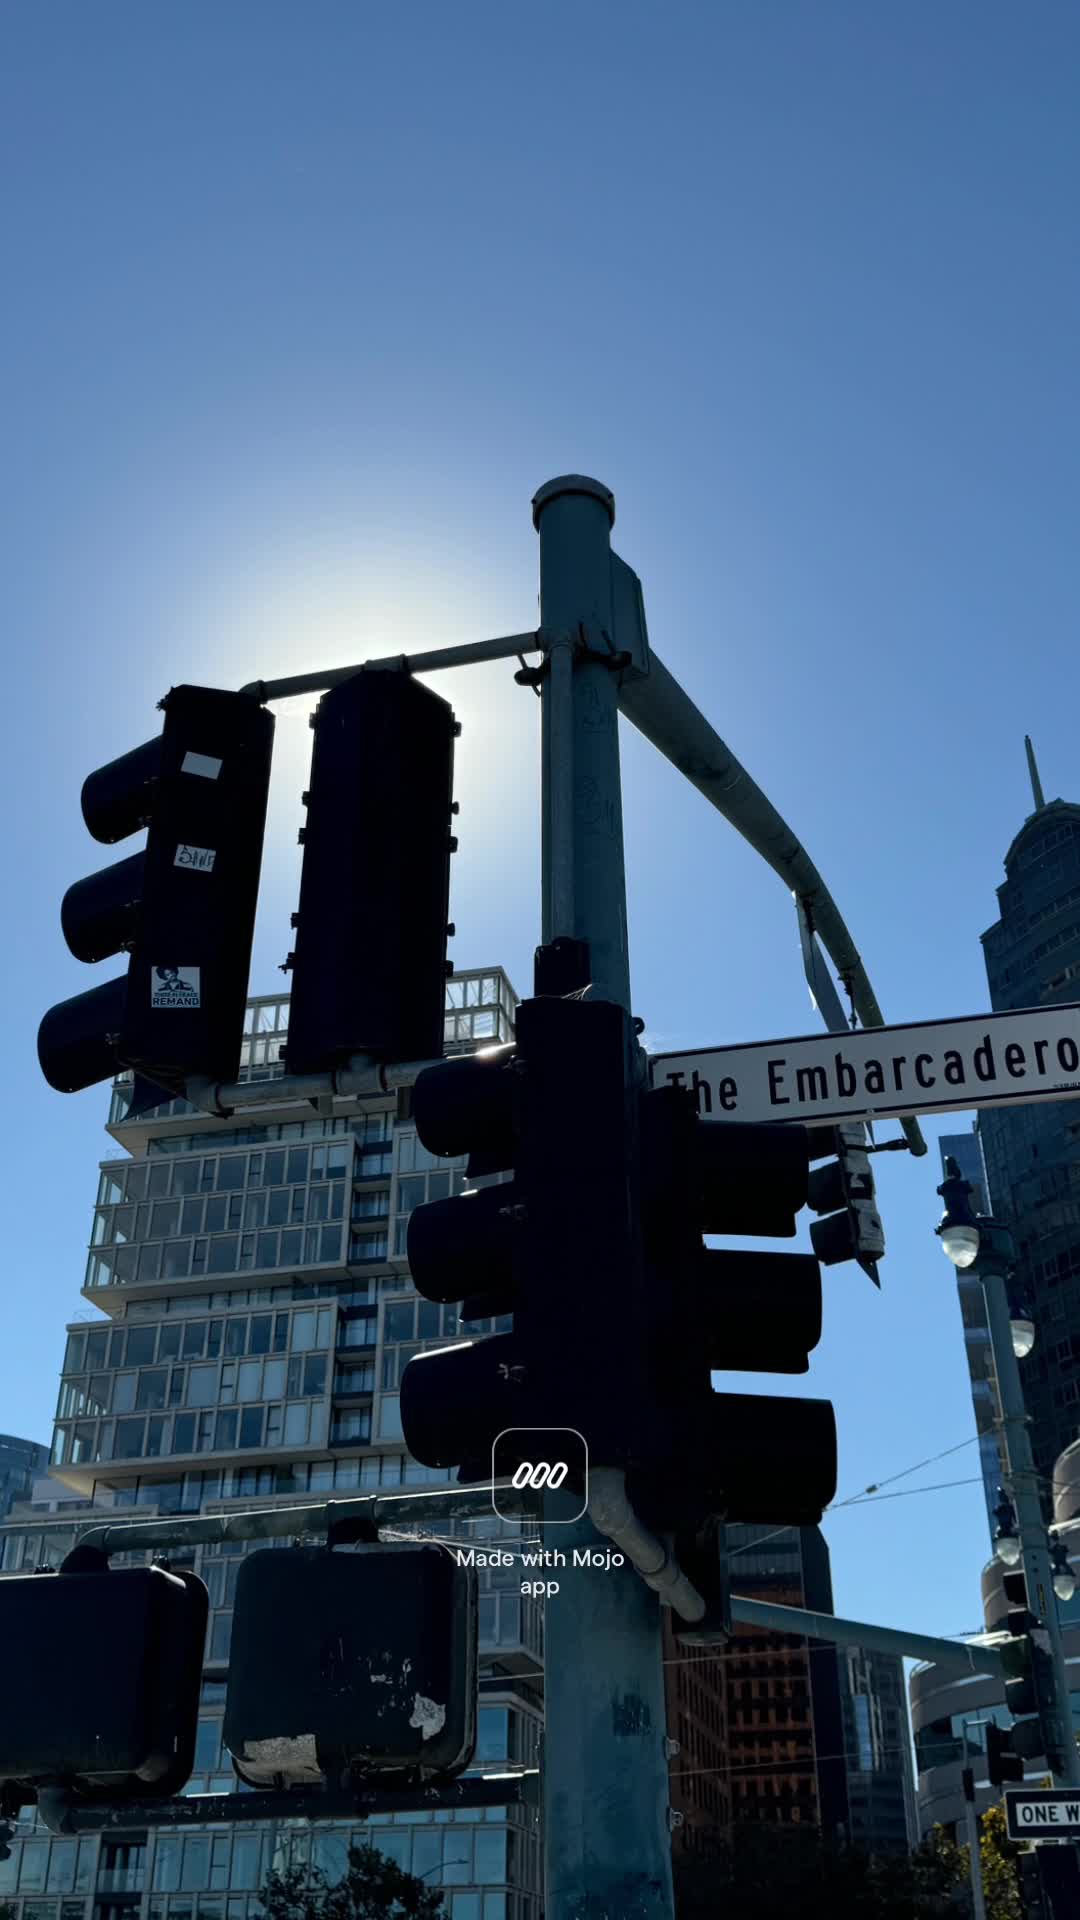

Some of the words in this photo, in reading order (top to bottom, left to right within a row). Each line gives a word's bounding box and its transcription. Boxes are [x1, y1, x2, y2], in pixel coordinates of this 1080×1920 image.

[152, 997, 199, 1006] REMAND
[767, 1034, 1079, 1105] Embarcadero
[1022, 1804, 1059, 1823] ONE
